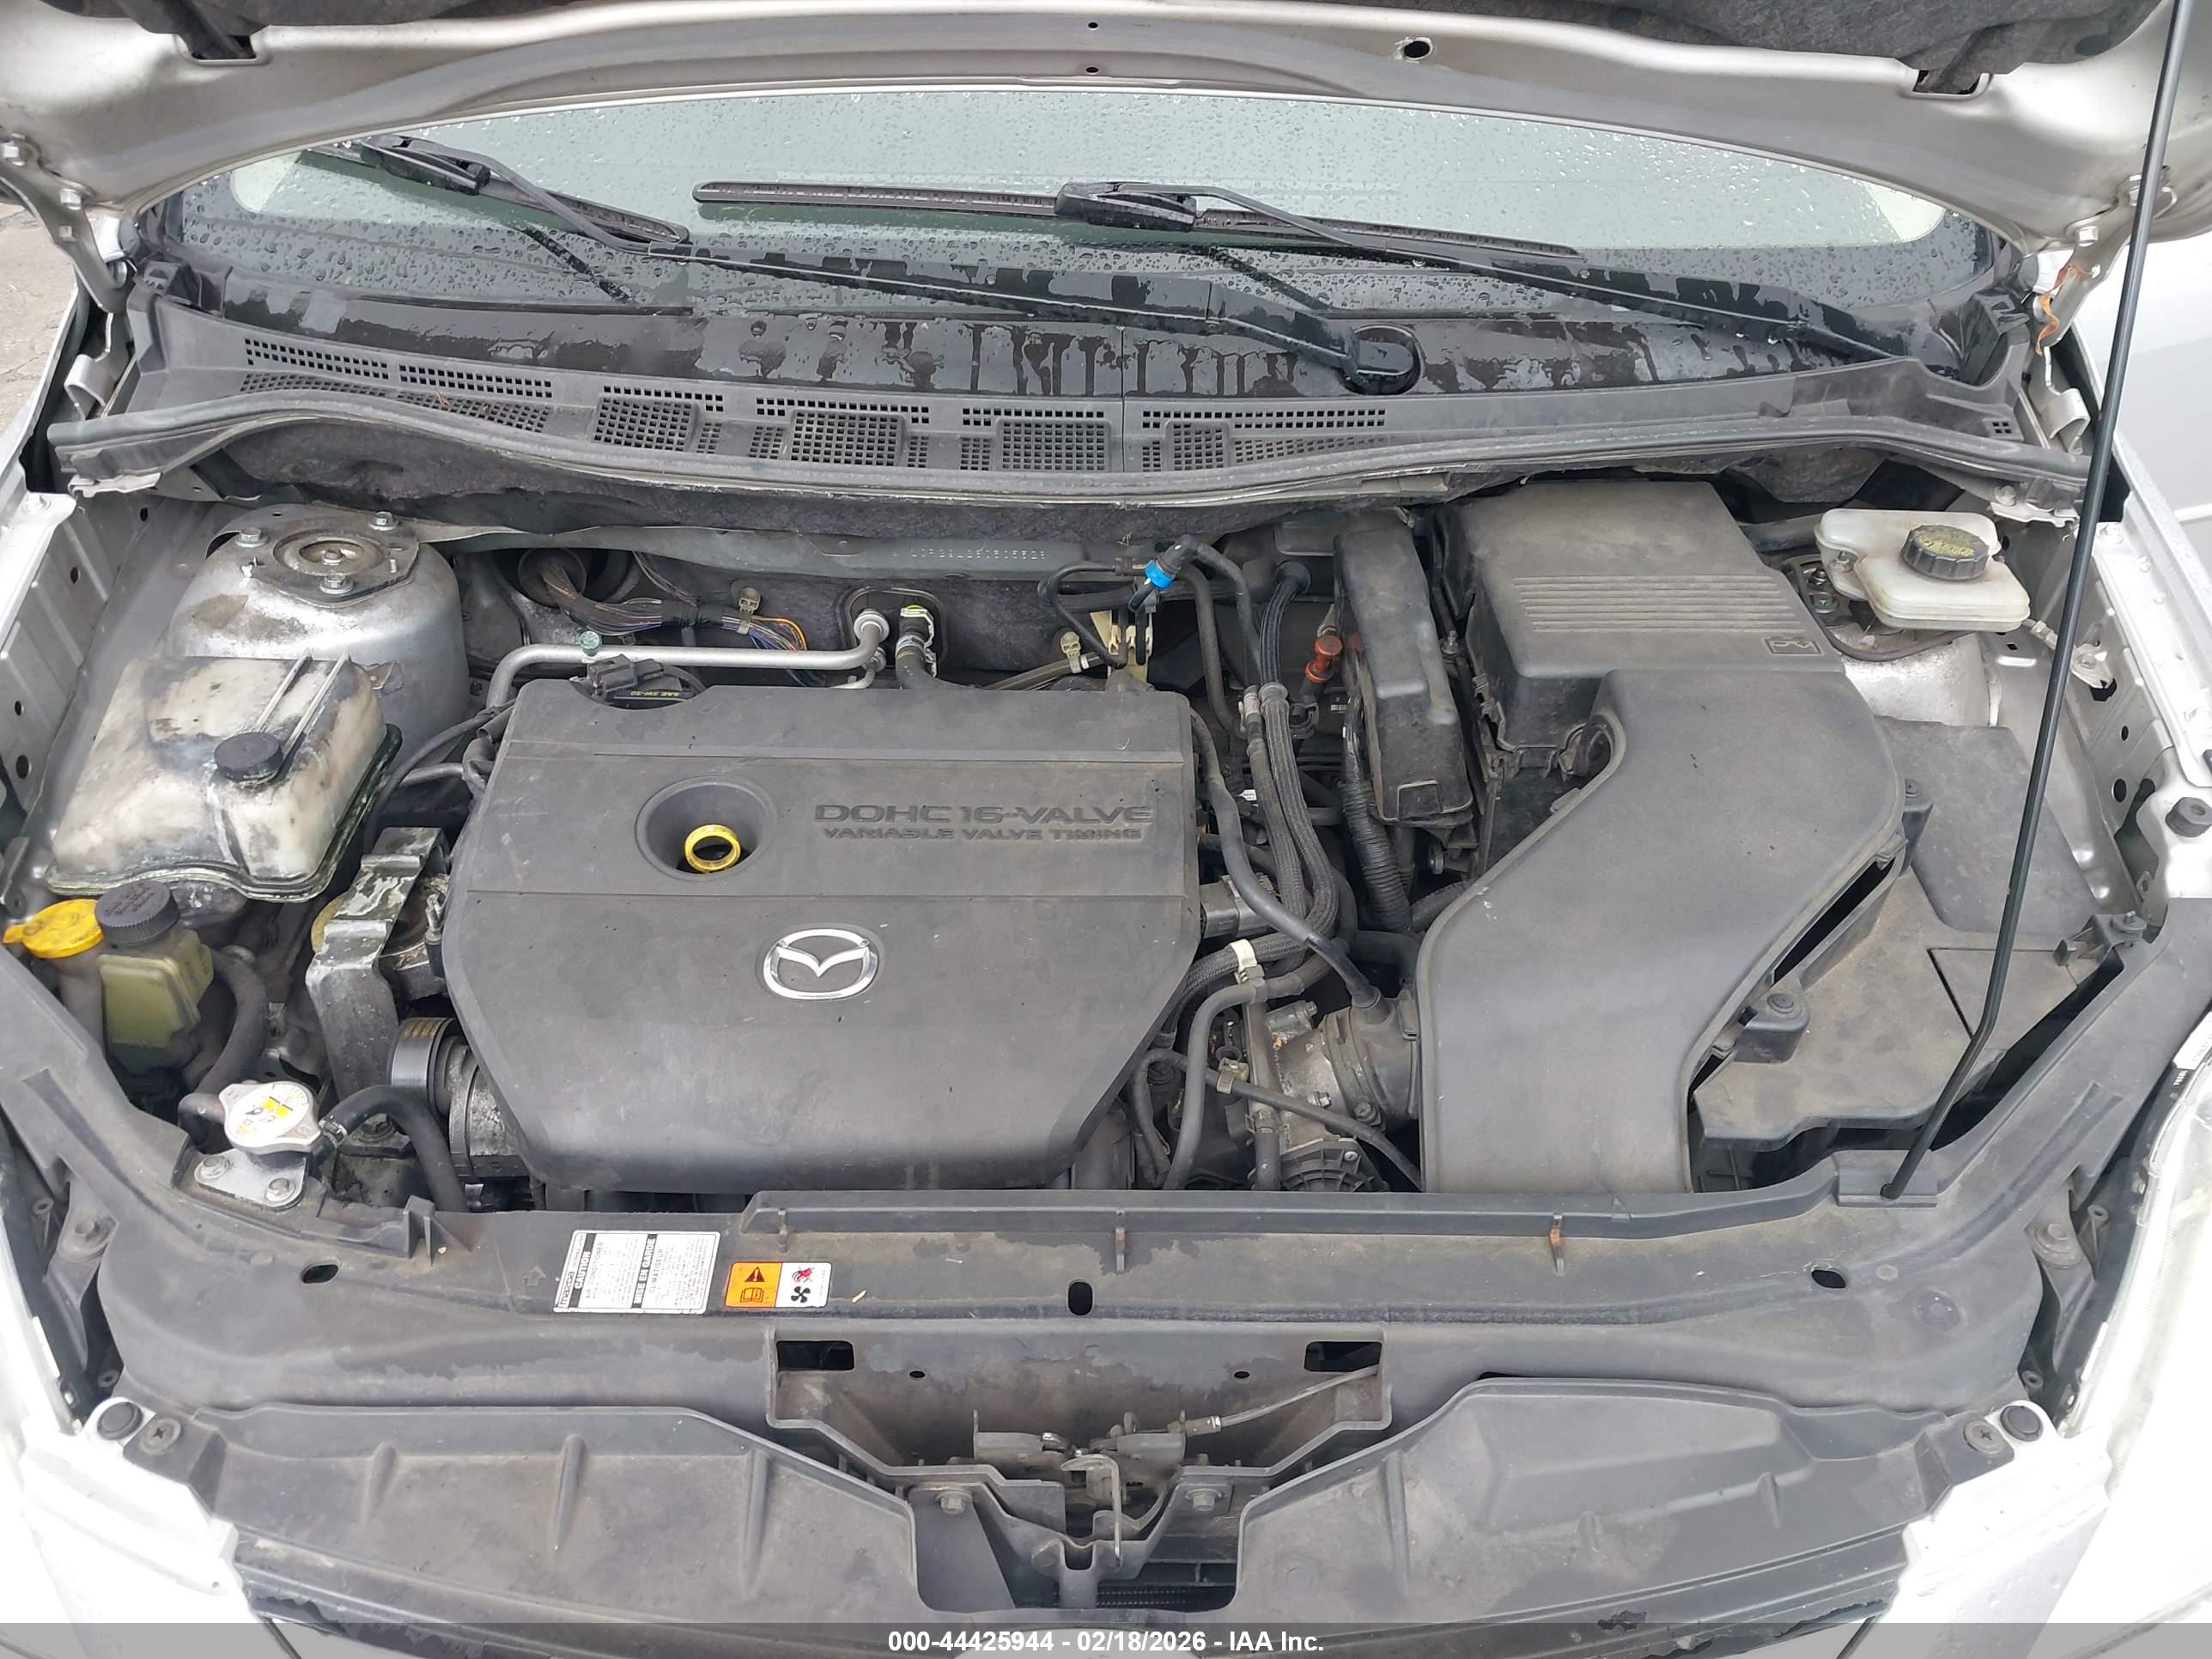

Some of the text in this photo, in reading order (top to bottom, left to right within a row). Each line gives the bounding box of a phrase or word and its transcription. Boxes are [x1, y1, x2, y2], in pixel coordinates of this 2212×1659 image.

[816, 805, 1153, 824] DOHC 16-VALVE
[823, 828, 1142, 841] VARIABLE VALVE TIMING
[574, 1250, 592, 1289] CAUTION
[633, 1237, 657, 1304] MISE EN GARDE
[560, 1271, 575, 1305] mazda
